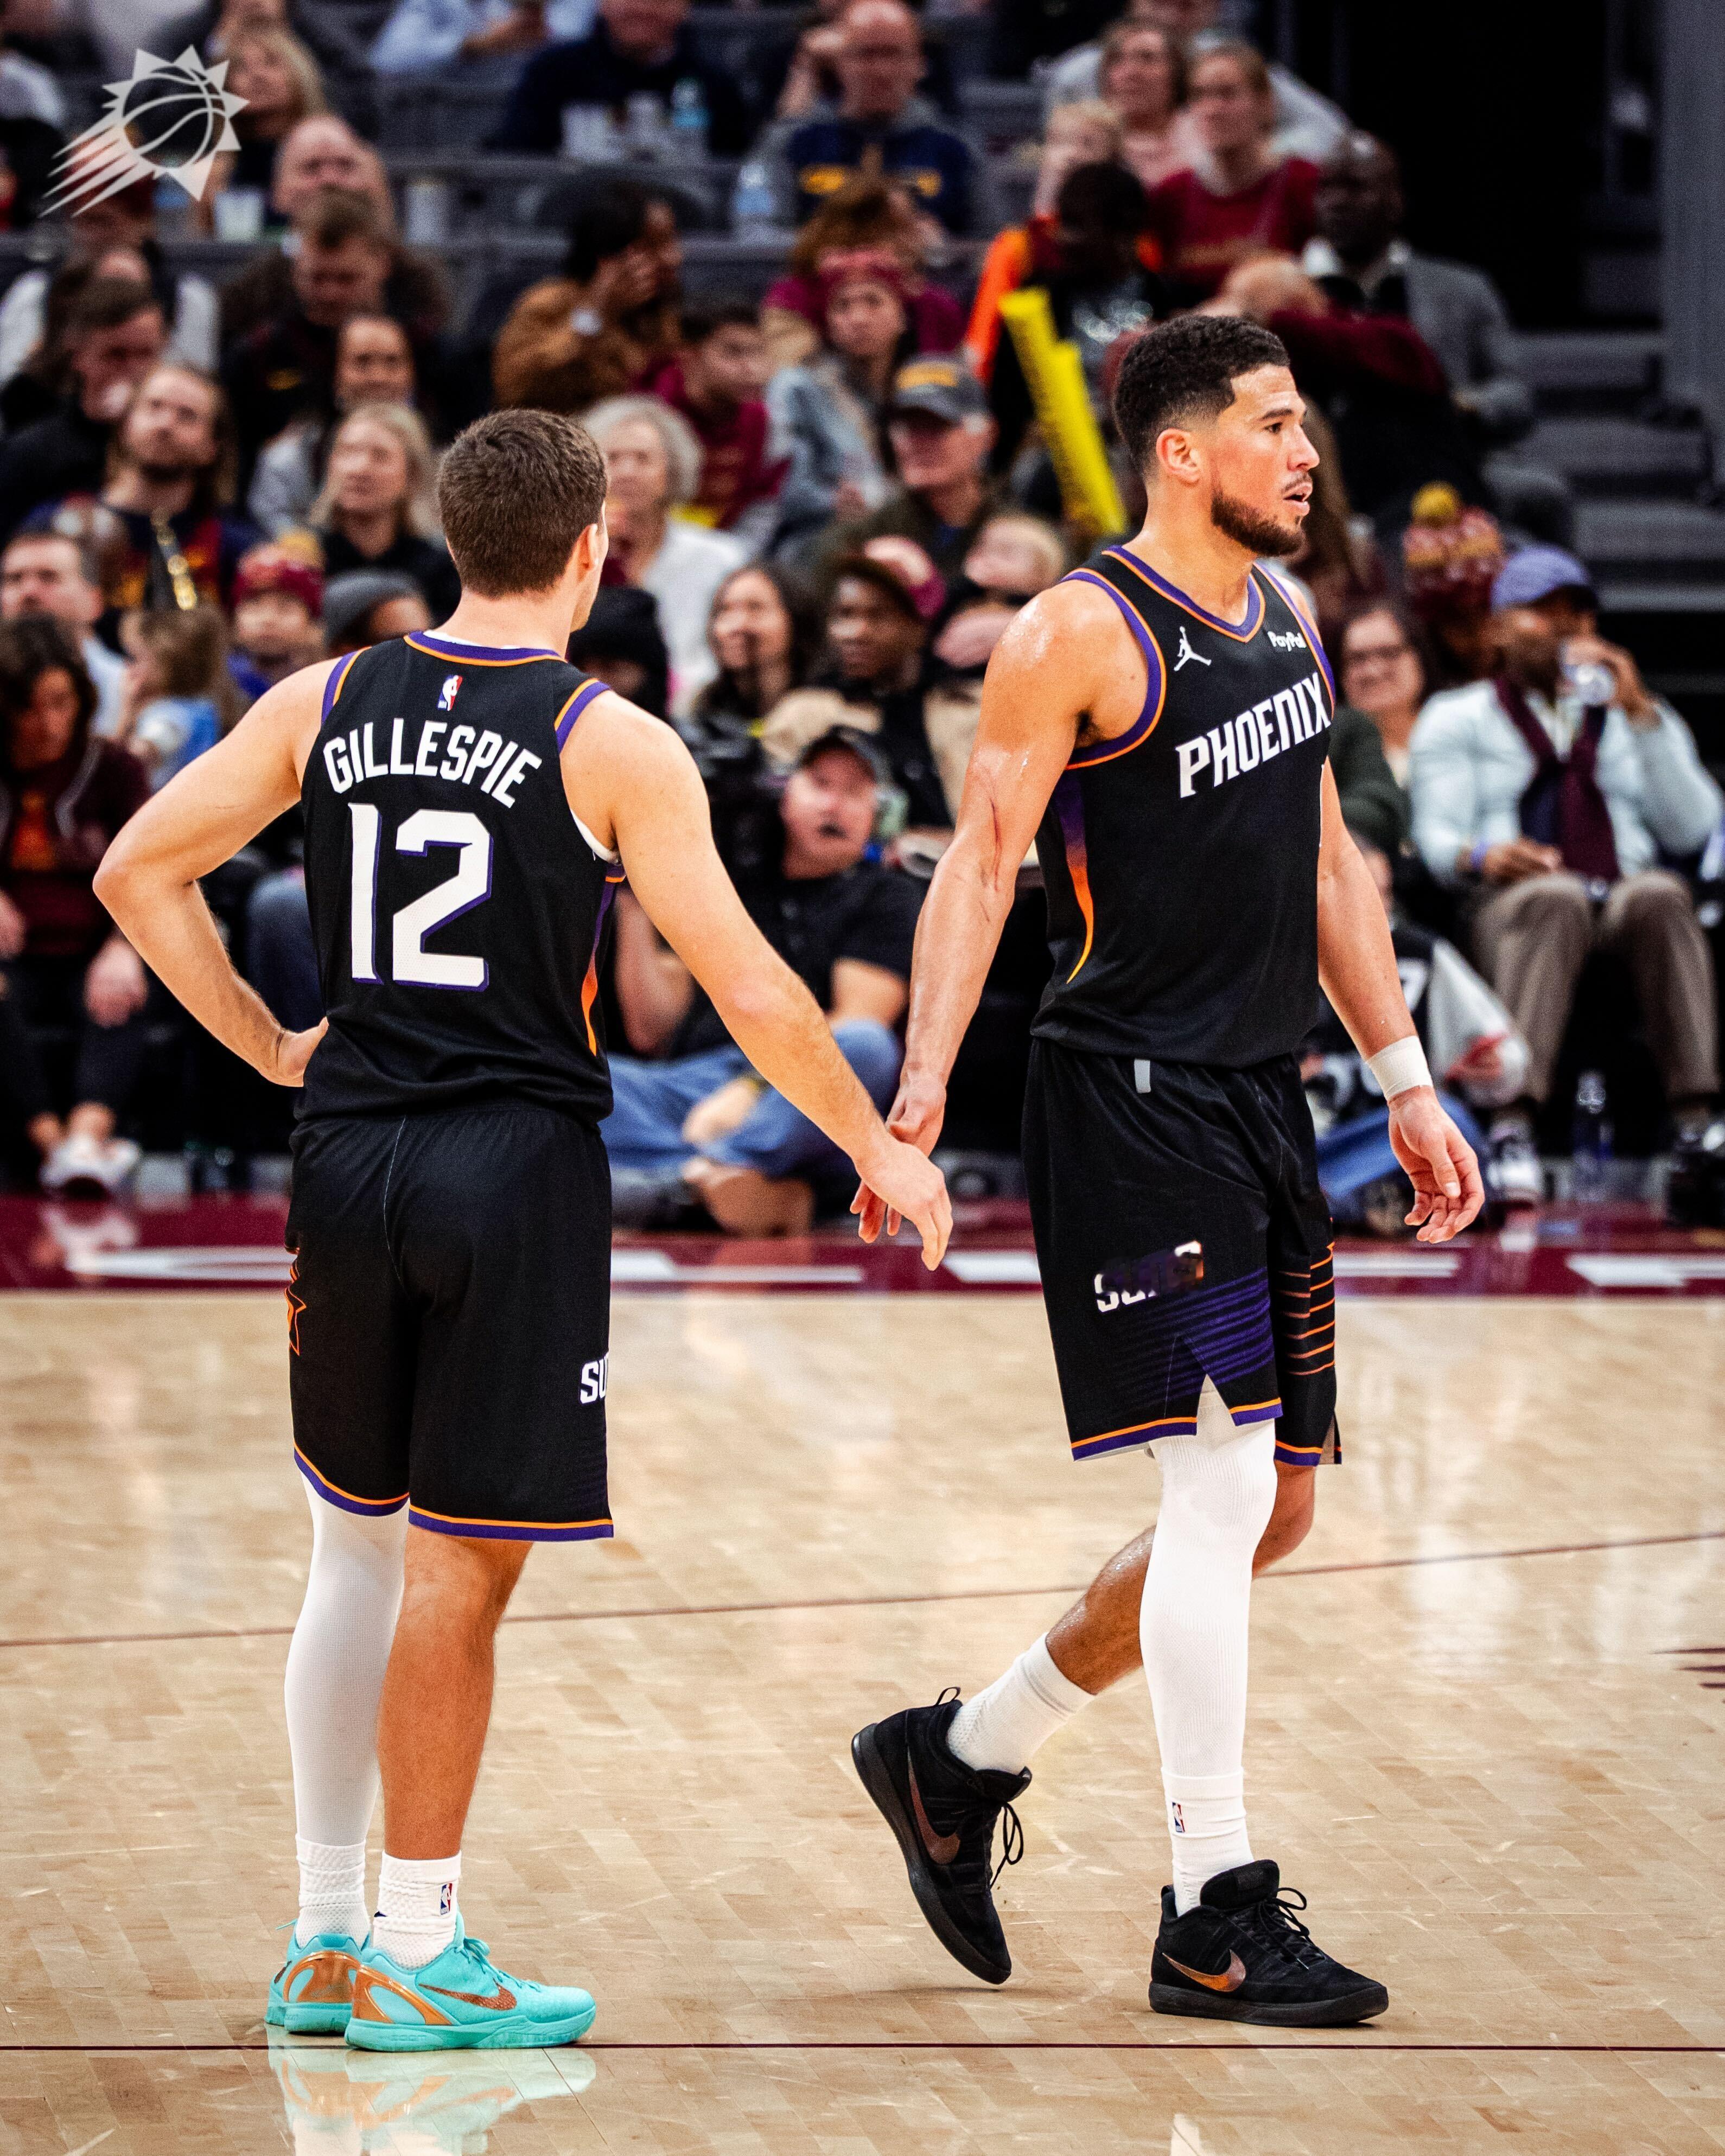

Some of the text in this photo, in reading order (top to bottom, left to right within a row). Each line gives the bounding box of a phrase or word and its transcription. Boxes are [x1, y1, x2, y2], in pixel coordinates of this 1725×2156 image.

[1267, 630, 1307, 652] PayPal
[323, 717, 543, 808] GILLESPIE
[1174, 671, 1332, 799] PHOENIX
[347, 802, 494, 992] 12
